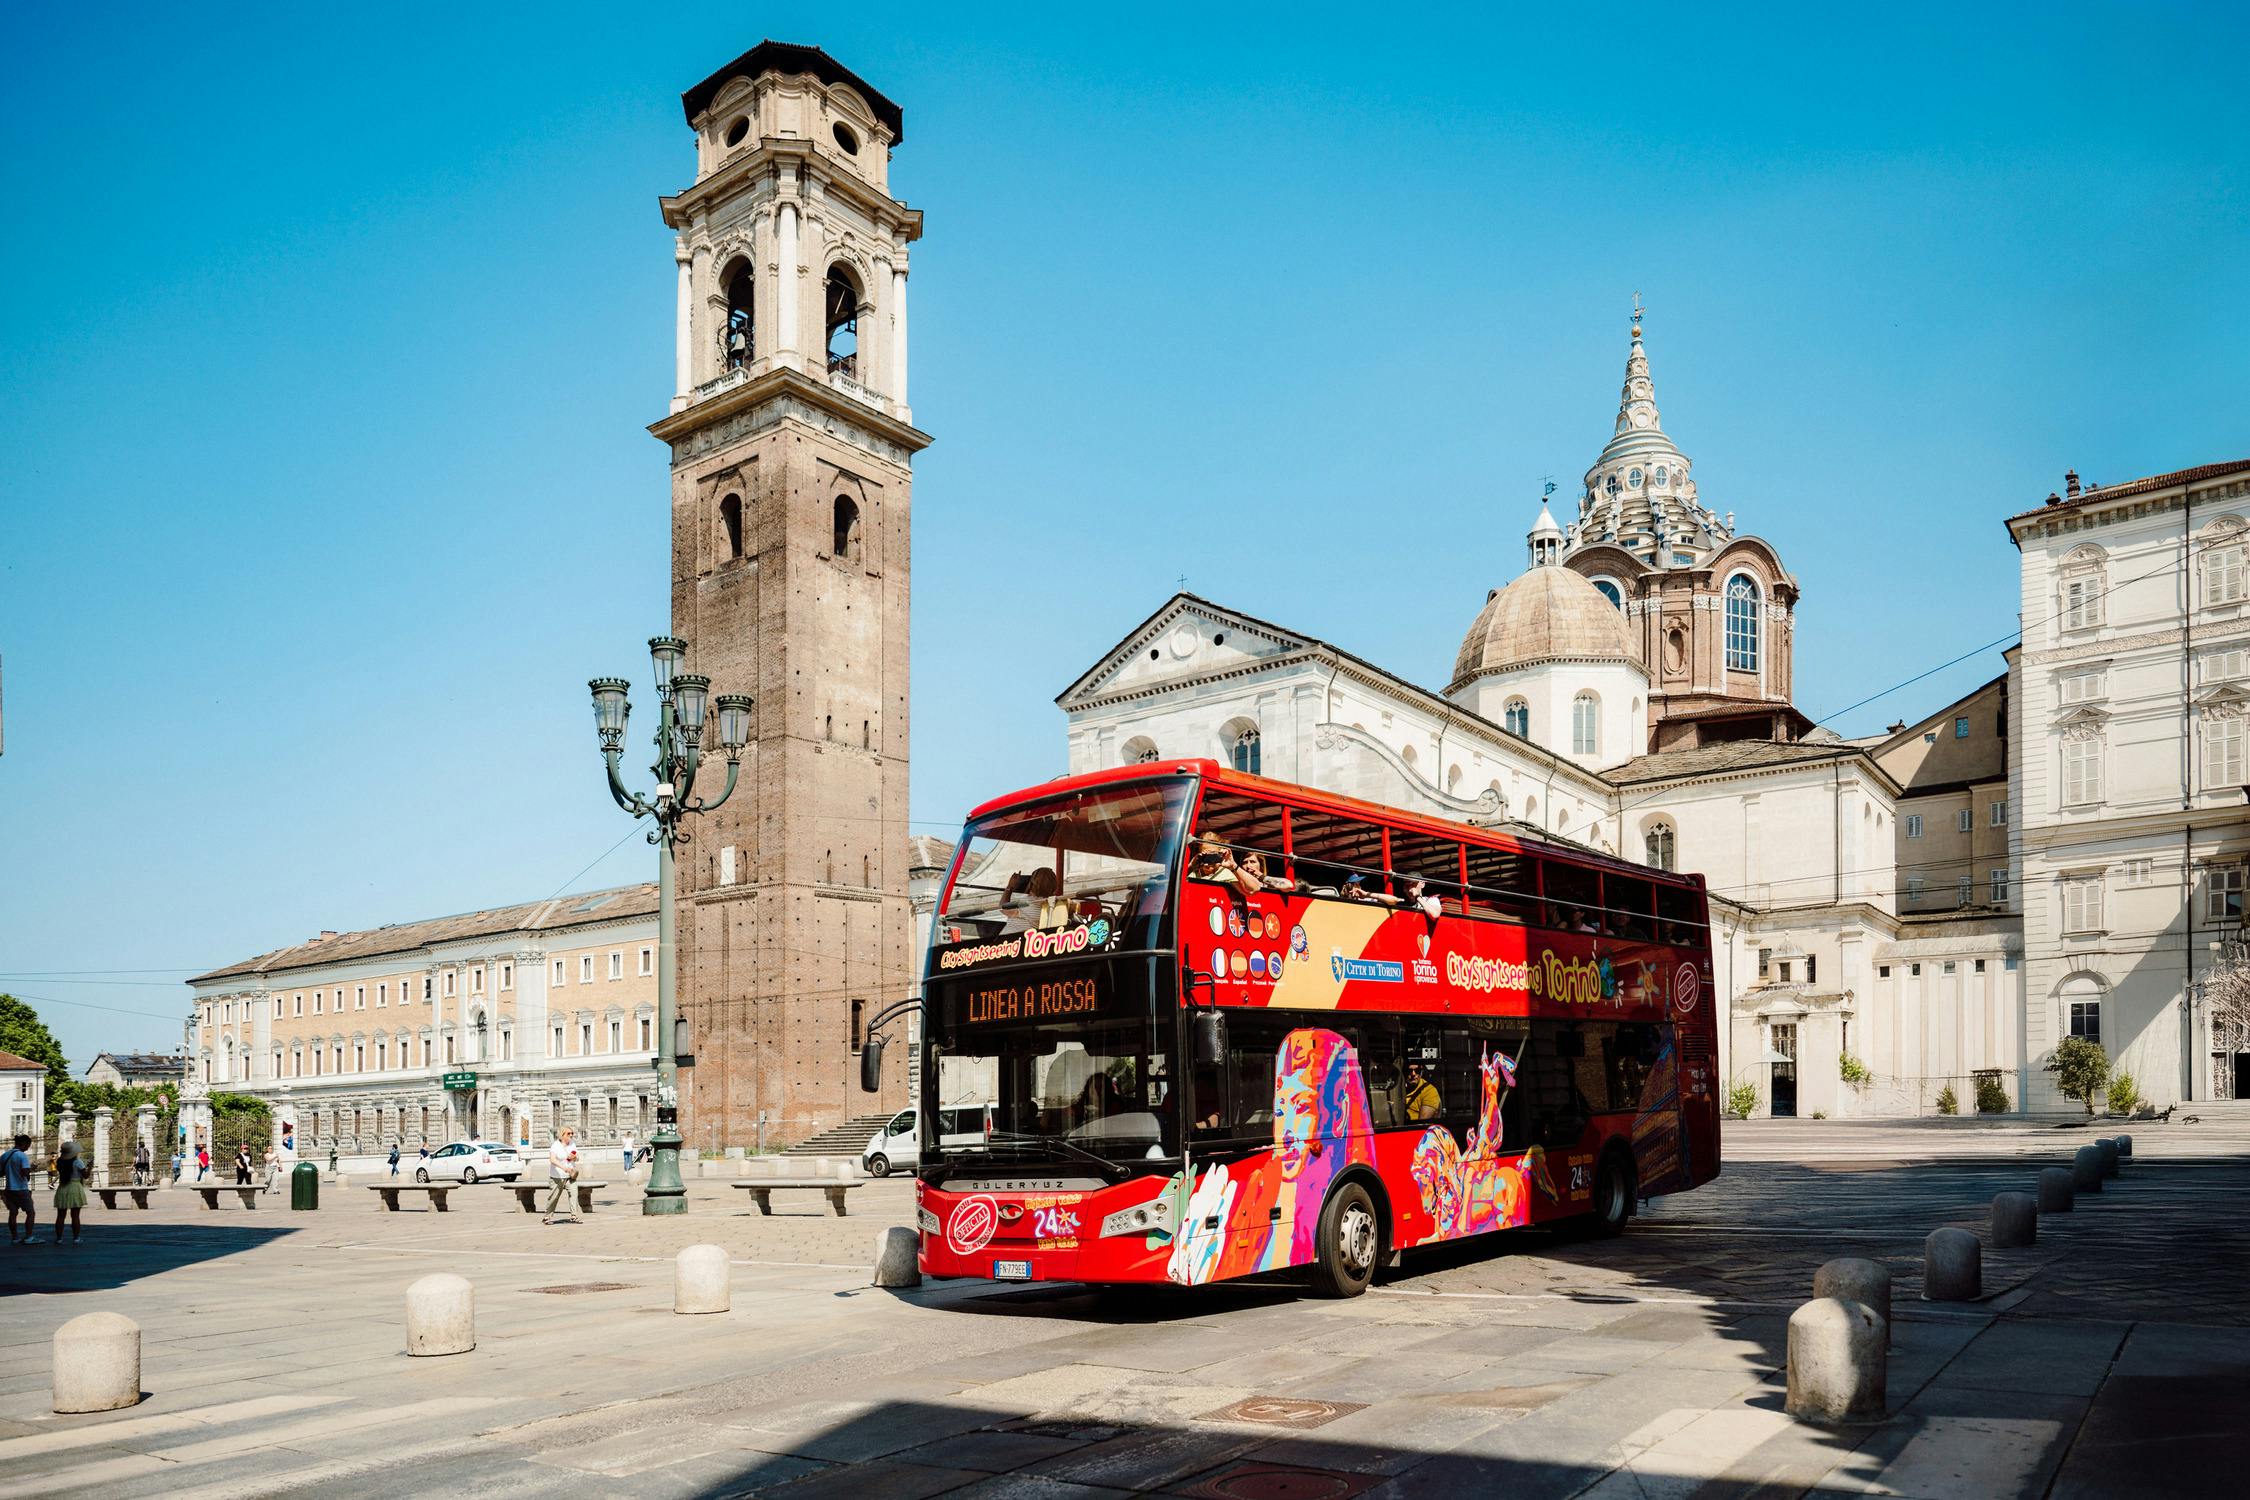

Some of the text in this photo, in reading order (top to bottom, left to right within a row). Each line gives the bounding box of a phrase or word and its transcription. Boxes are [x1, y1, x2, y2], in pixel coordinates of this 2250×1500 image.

[941, 924, 1089, 969] CitySightseeing Torino
[1411, 960, 1438, 976] Torino
[1446, 949, 1601, 1004] CitySightseeing Torino
[970, 979, 1096, 1022] LINEA A ROSSA
[1571, 1165, 1582, 1190] 24
[957, 1208, 987, 1239] OFFICIAL
[1034, 1208, 1058, 1238] 24
